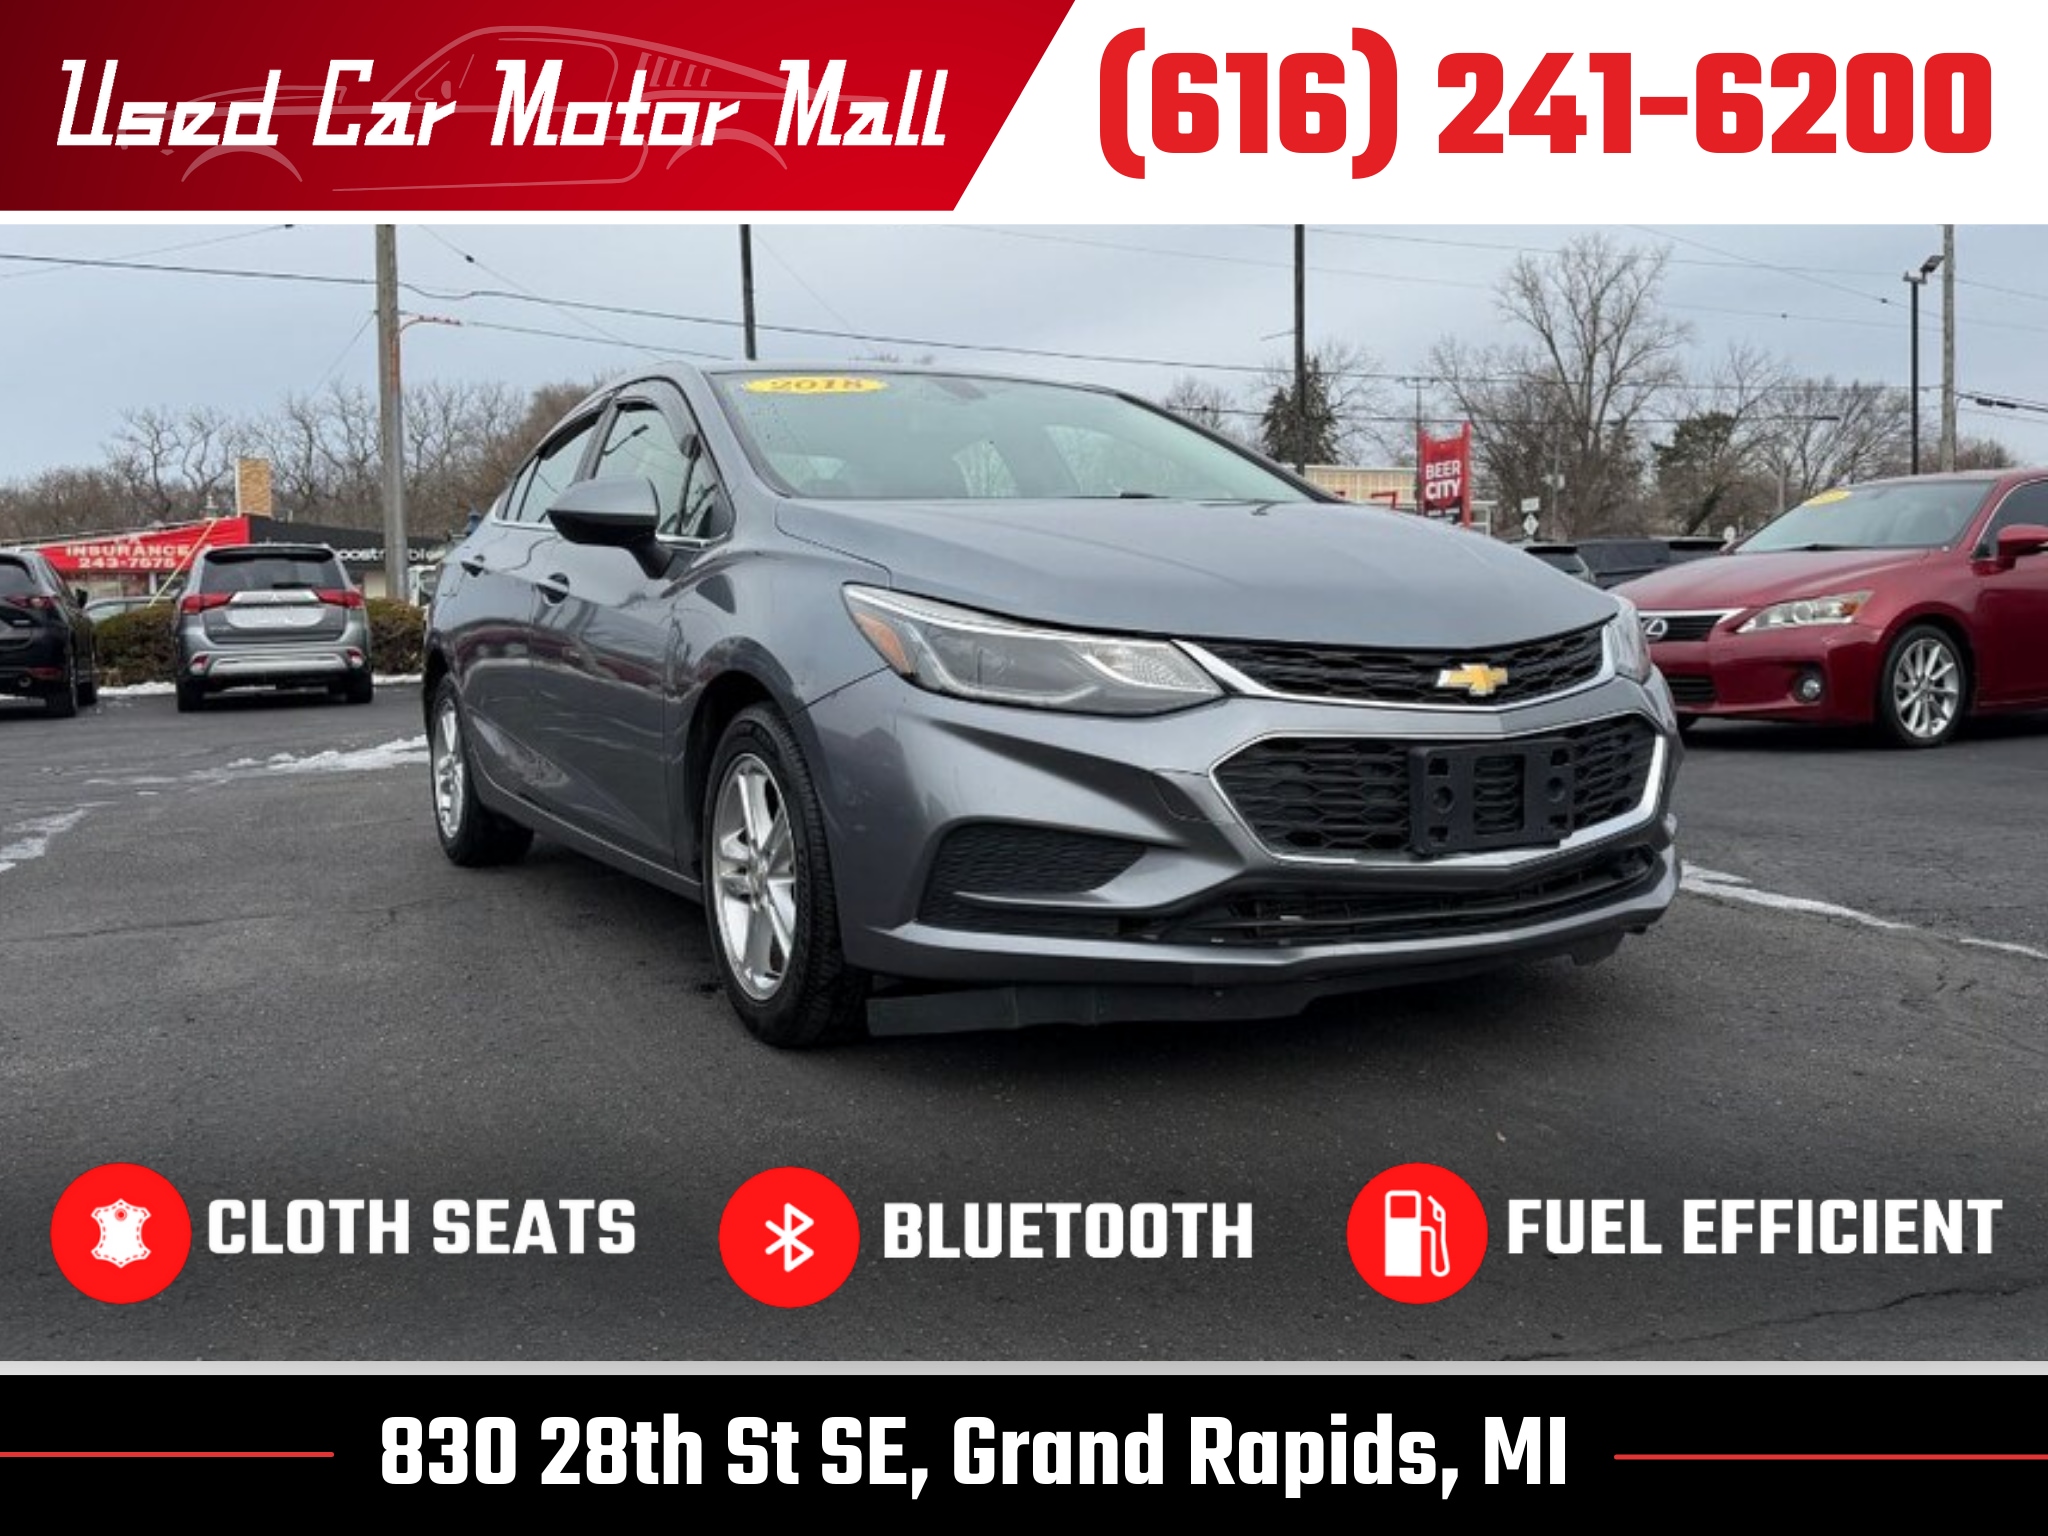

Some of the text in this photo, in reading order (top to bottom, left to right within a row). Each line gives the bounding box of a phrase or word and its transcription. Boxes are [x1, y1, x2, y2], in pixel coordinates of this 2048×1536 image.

[1425, 460, 1464, 479] BEER
[1425, 478, 1462, 499] CITY
[65, 544, 191, 557] INSURANCE
